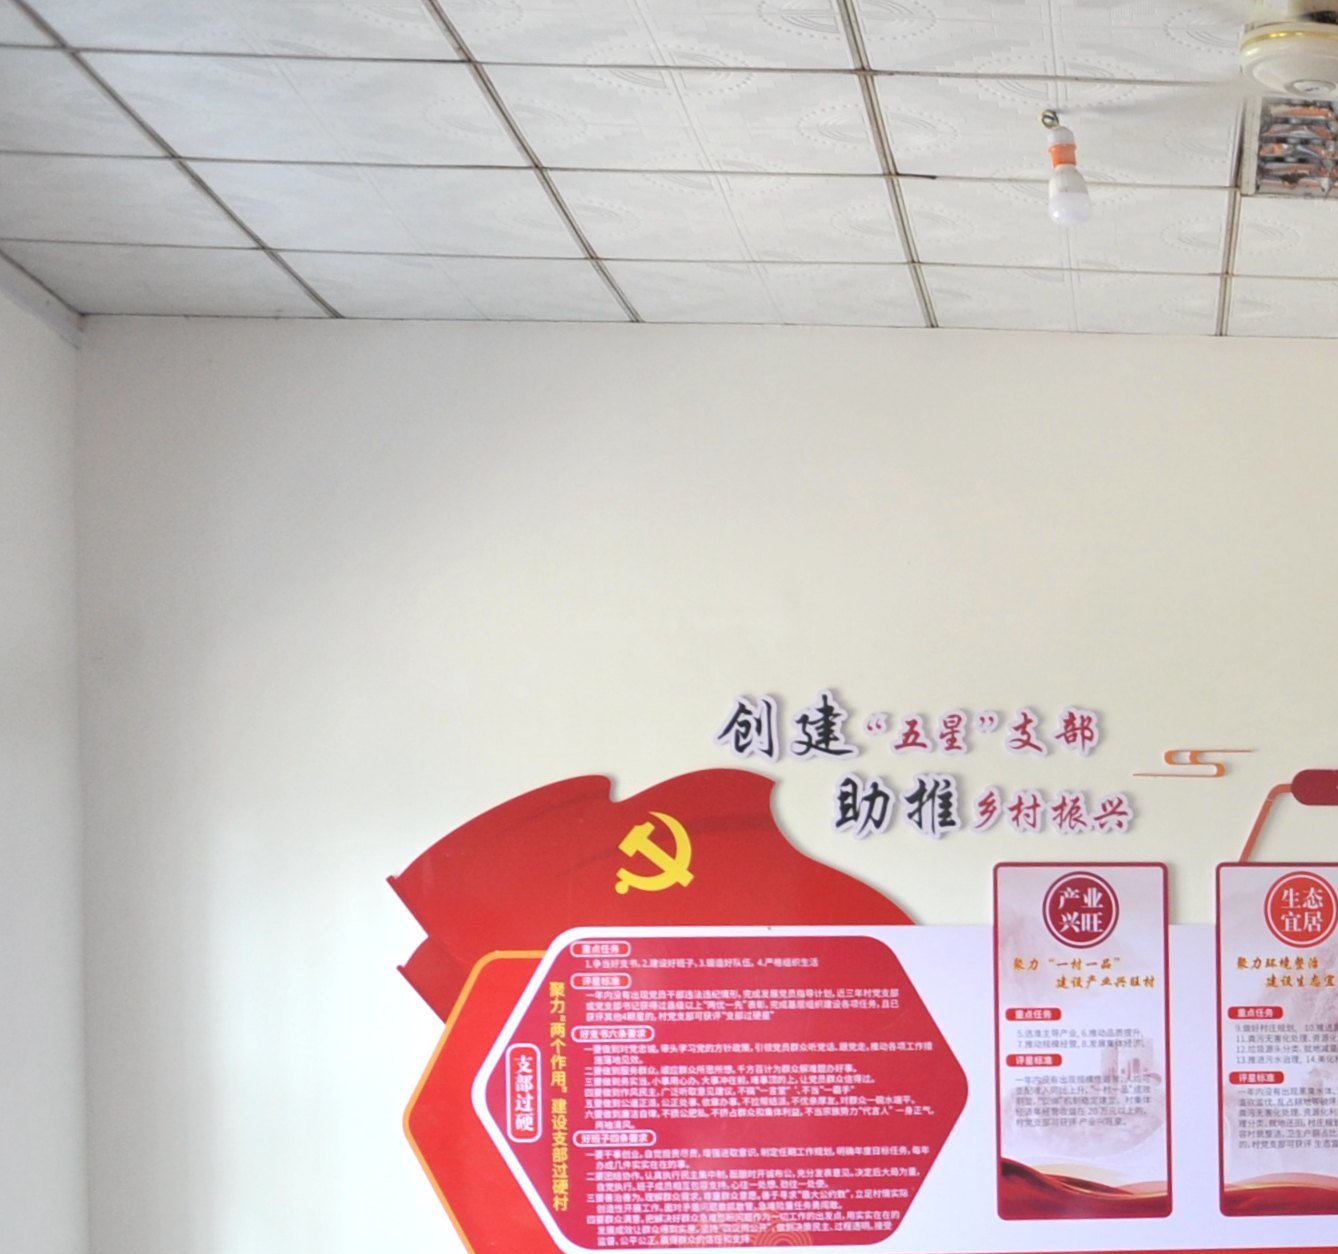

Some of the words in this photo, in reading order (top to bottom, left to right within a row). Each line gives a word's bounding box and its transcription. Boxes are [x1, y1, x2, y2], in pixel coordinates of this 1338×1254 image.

[716, 692, 1100, 760] 创建“五星”支部
[833, 775, 1131, 837] 助推乡村振兴
[1058, 887, 1103, 910] 产业
[1281, 887, 1324, 909] 生态
[1059, 911, 1103, 934] 兴旺
[1281, 911, 1324, 933] 宜居
[581, 944, 620, 954] 重点任务
[1237, 956, 1319, 970] 聚力环境整治
[582, 976, 620, 986] 评星标准
[1055, 974, 1155, 989] 建设产业兴旺村
[1015, 1010, 1052, 1020] 重点任务
[1237, 1009, 1273, 1019] 重点任务
[579, 1029, 647, 1039] 好支书六条要求
[1015, 1056, 1052, 1066] 评星标准
[1238, 1073, 1275, 1083] 评星标准
[514, 1055, 534, 1132] 支部过硬
[581, 1133, 649, 1144] 好班子四条要求
